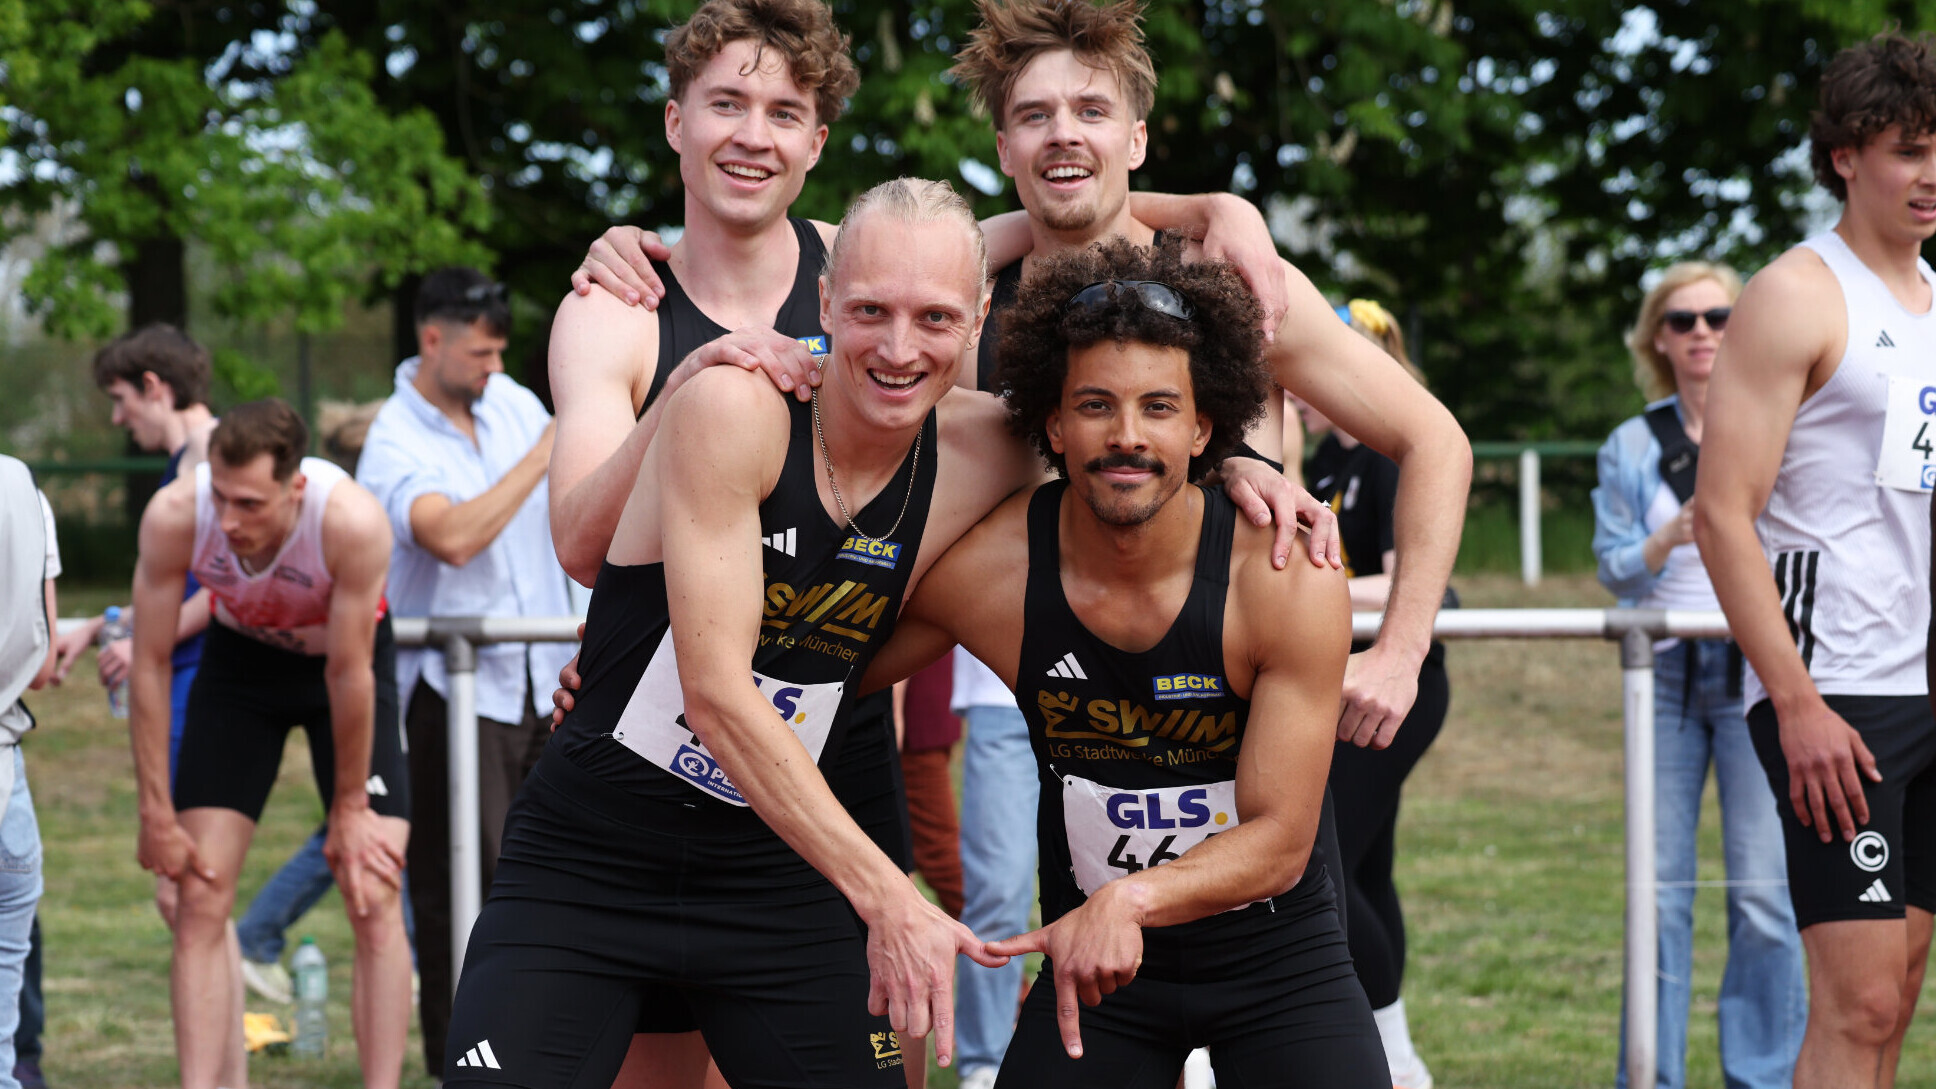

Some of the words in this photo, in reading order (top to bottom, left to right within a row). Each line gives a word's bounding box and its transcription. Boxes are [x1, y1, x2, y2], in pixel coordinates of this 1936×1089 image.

[842, 537, 898, 559] BECK
[1156, 675, 1219, 691] BECK
[1050, 743, 1071, 759] LG
[1107, 833, 1221, 875] 46
